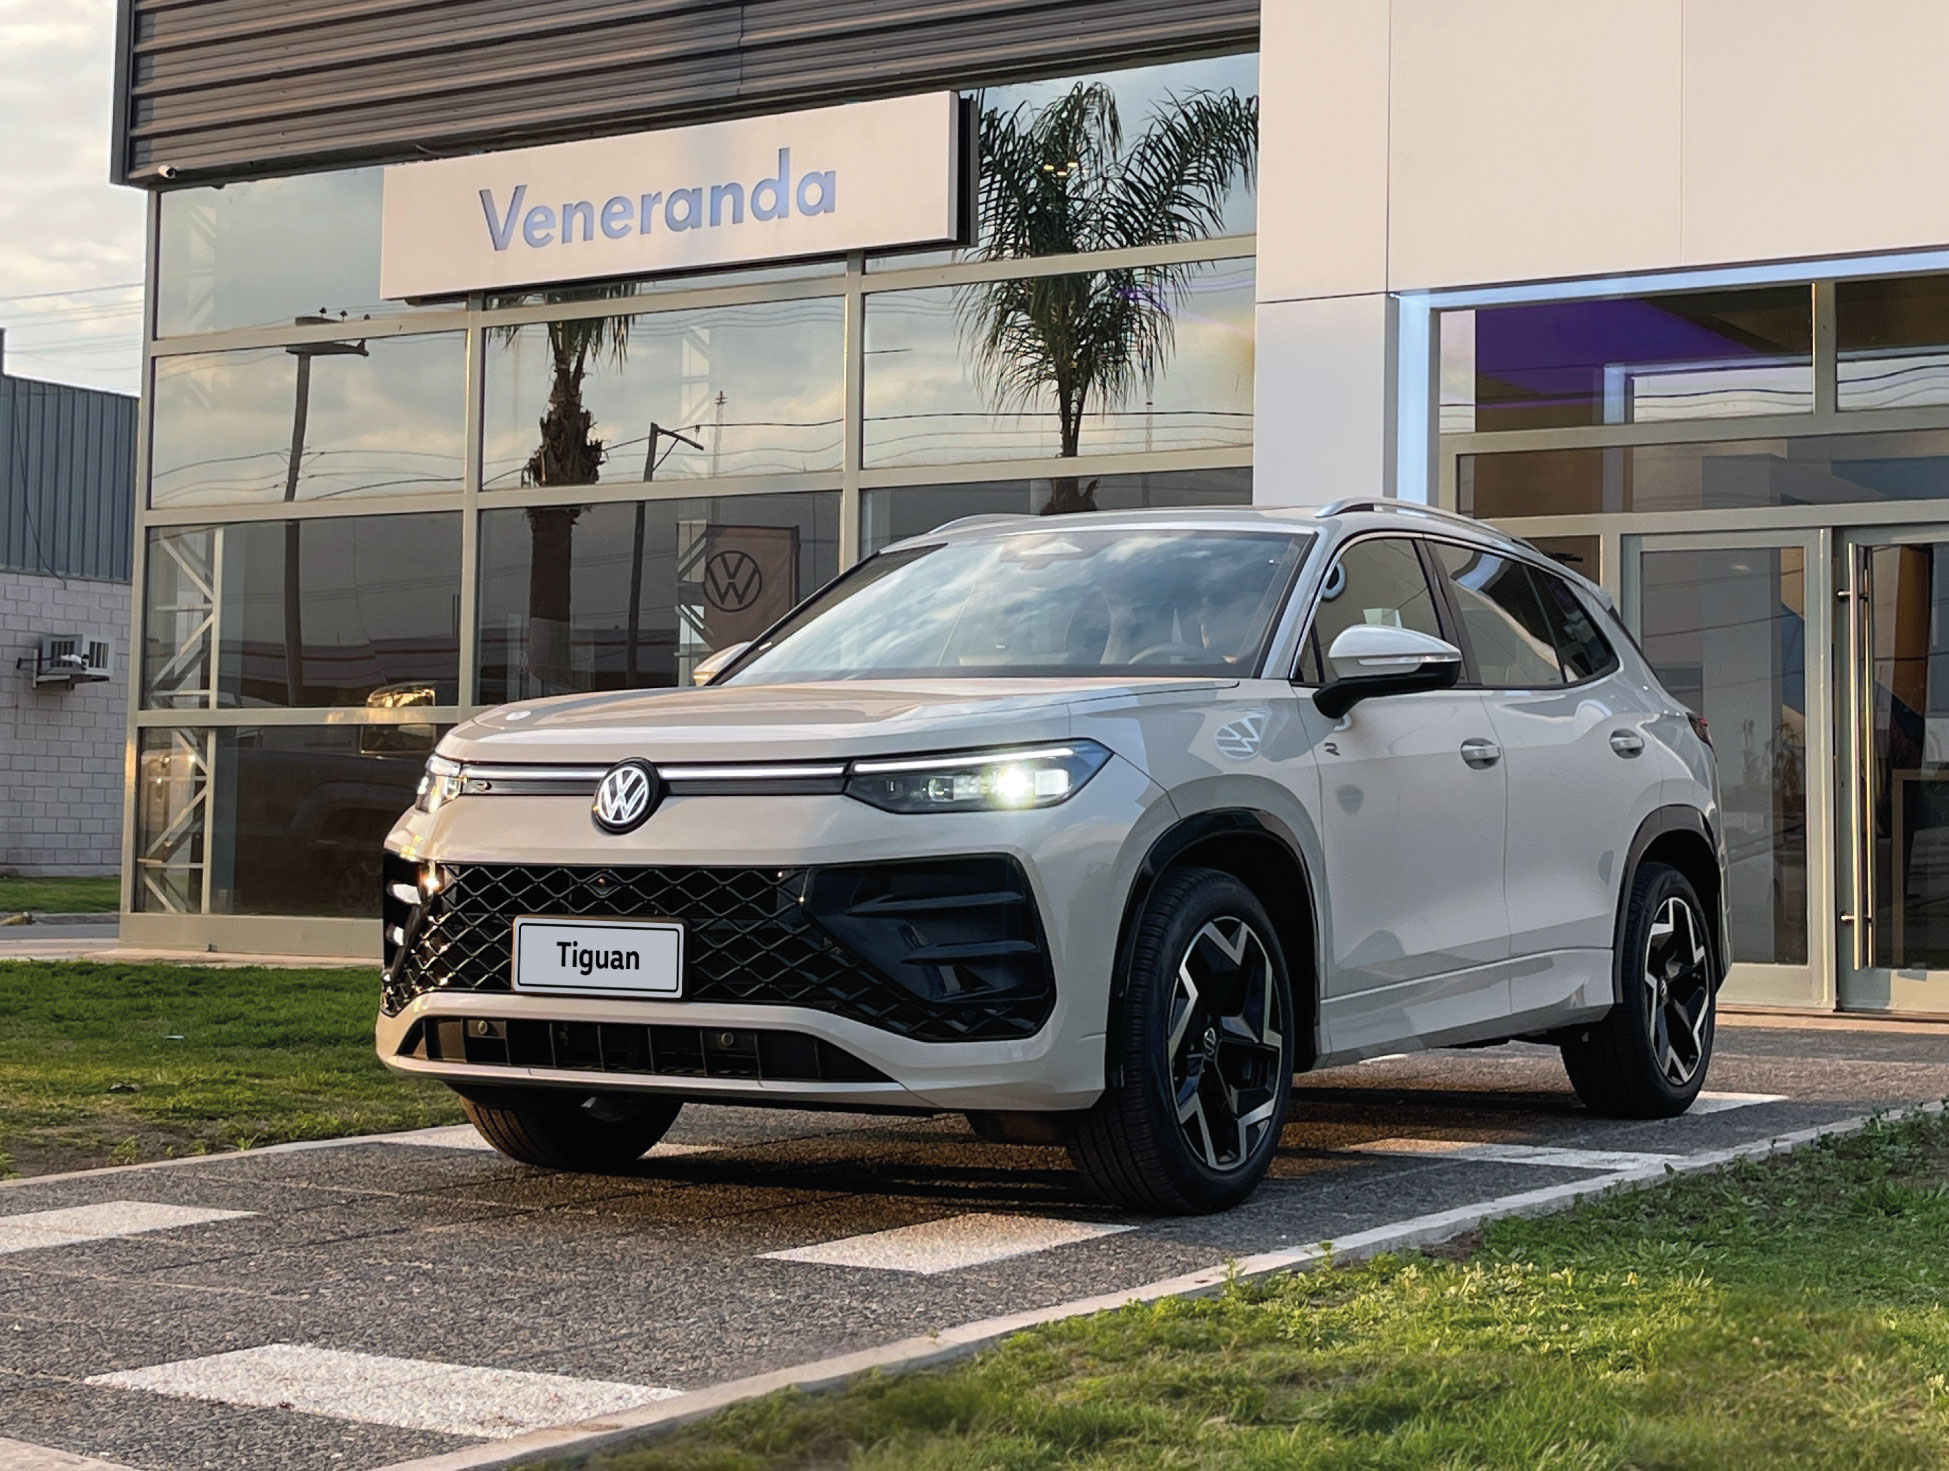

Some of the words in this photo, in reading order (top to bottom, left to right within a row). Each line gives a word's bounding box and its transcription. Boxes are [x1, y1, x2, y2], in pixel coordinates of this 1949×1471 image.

[478, 147, 837, 252] Veneranda
[704, 551, 762, 612] VW
[599, 766, 649, 823] VW
[556, 940, 640, 976] Tiguan
